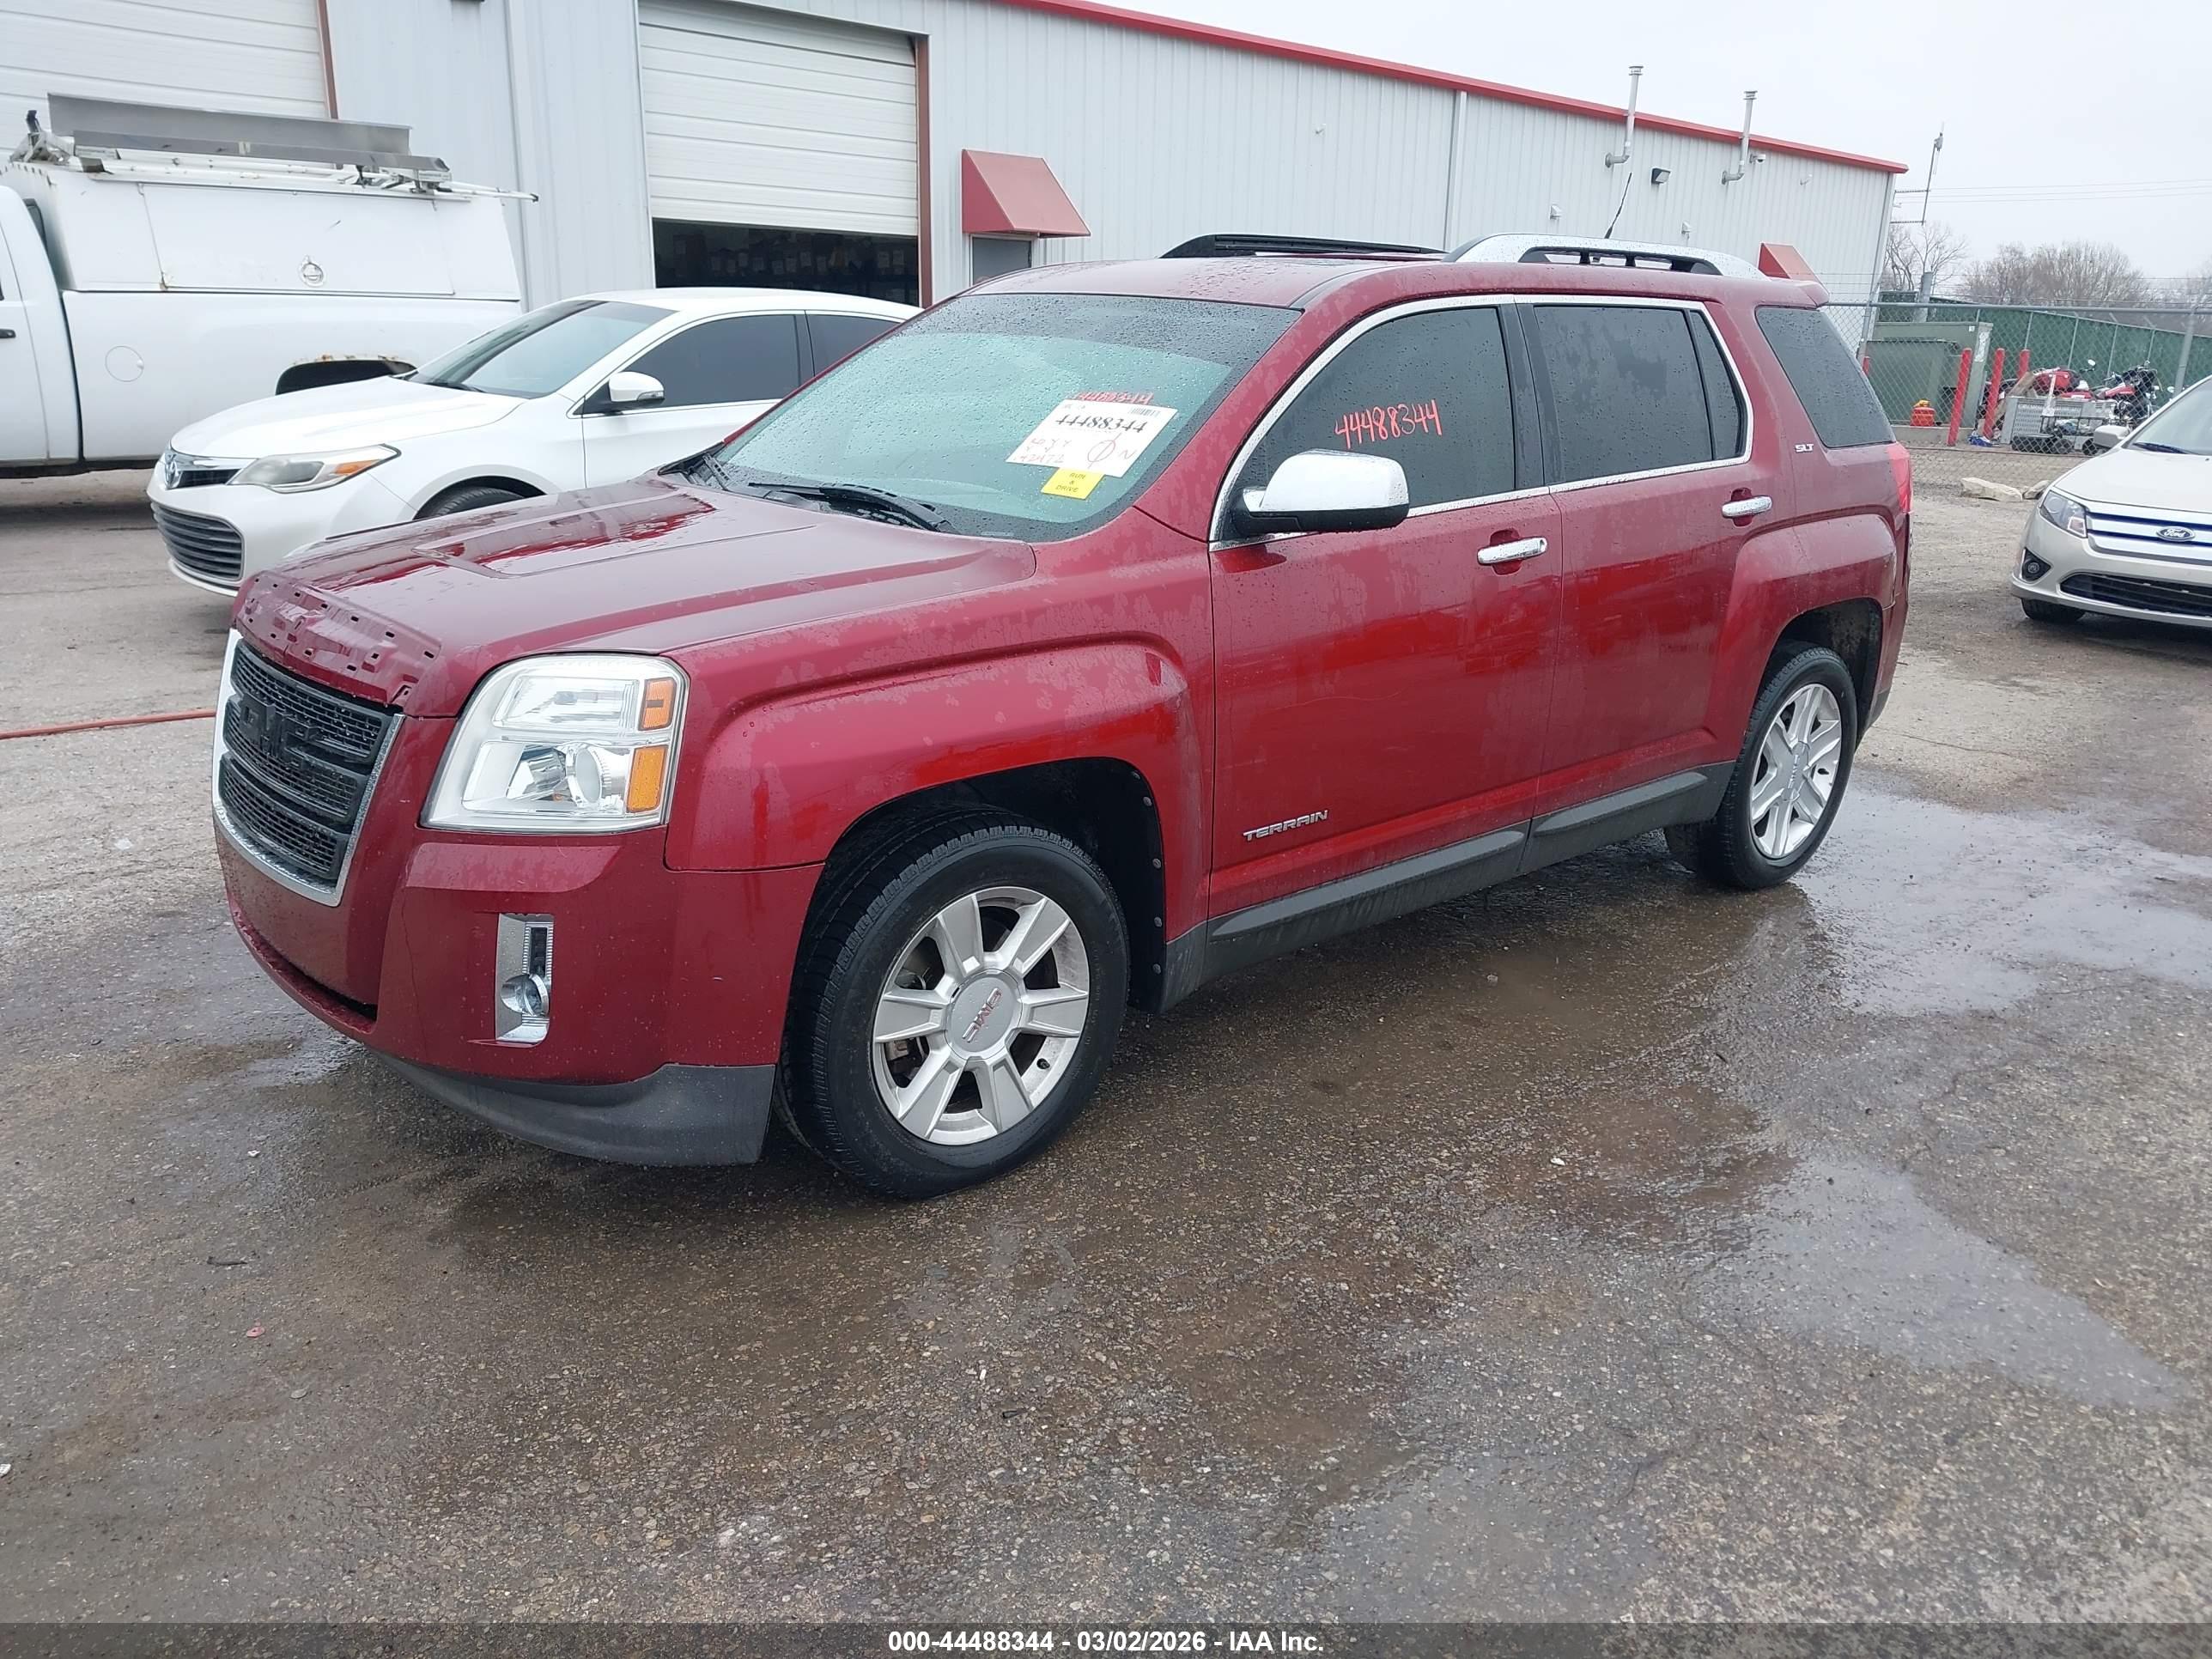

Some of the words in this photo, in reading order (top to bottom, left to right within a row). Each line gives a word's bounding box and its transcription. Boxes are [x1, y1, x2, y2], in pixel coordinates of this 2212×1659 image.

[1055, 414, 1148, 433] 44488344
[1334, 398, 1443, 449] 44488344
[1795, 443, 1814, 453] SLT
[1069, 471, 1086, 480] RUN
[1055, 484, 1079, 493] DRIVE
[1243, 810, 1328, 842] TERRAIN
[962, 988, 1002, 1043] GMC
